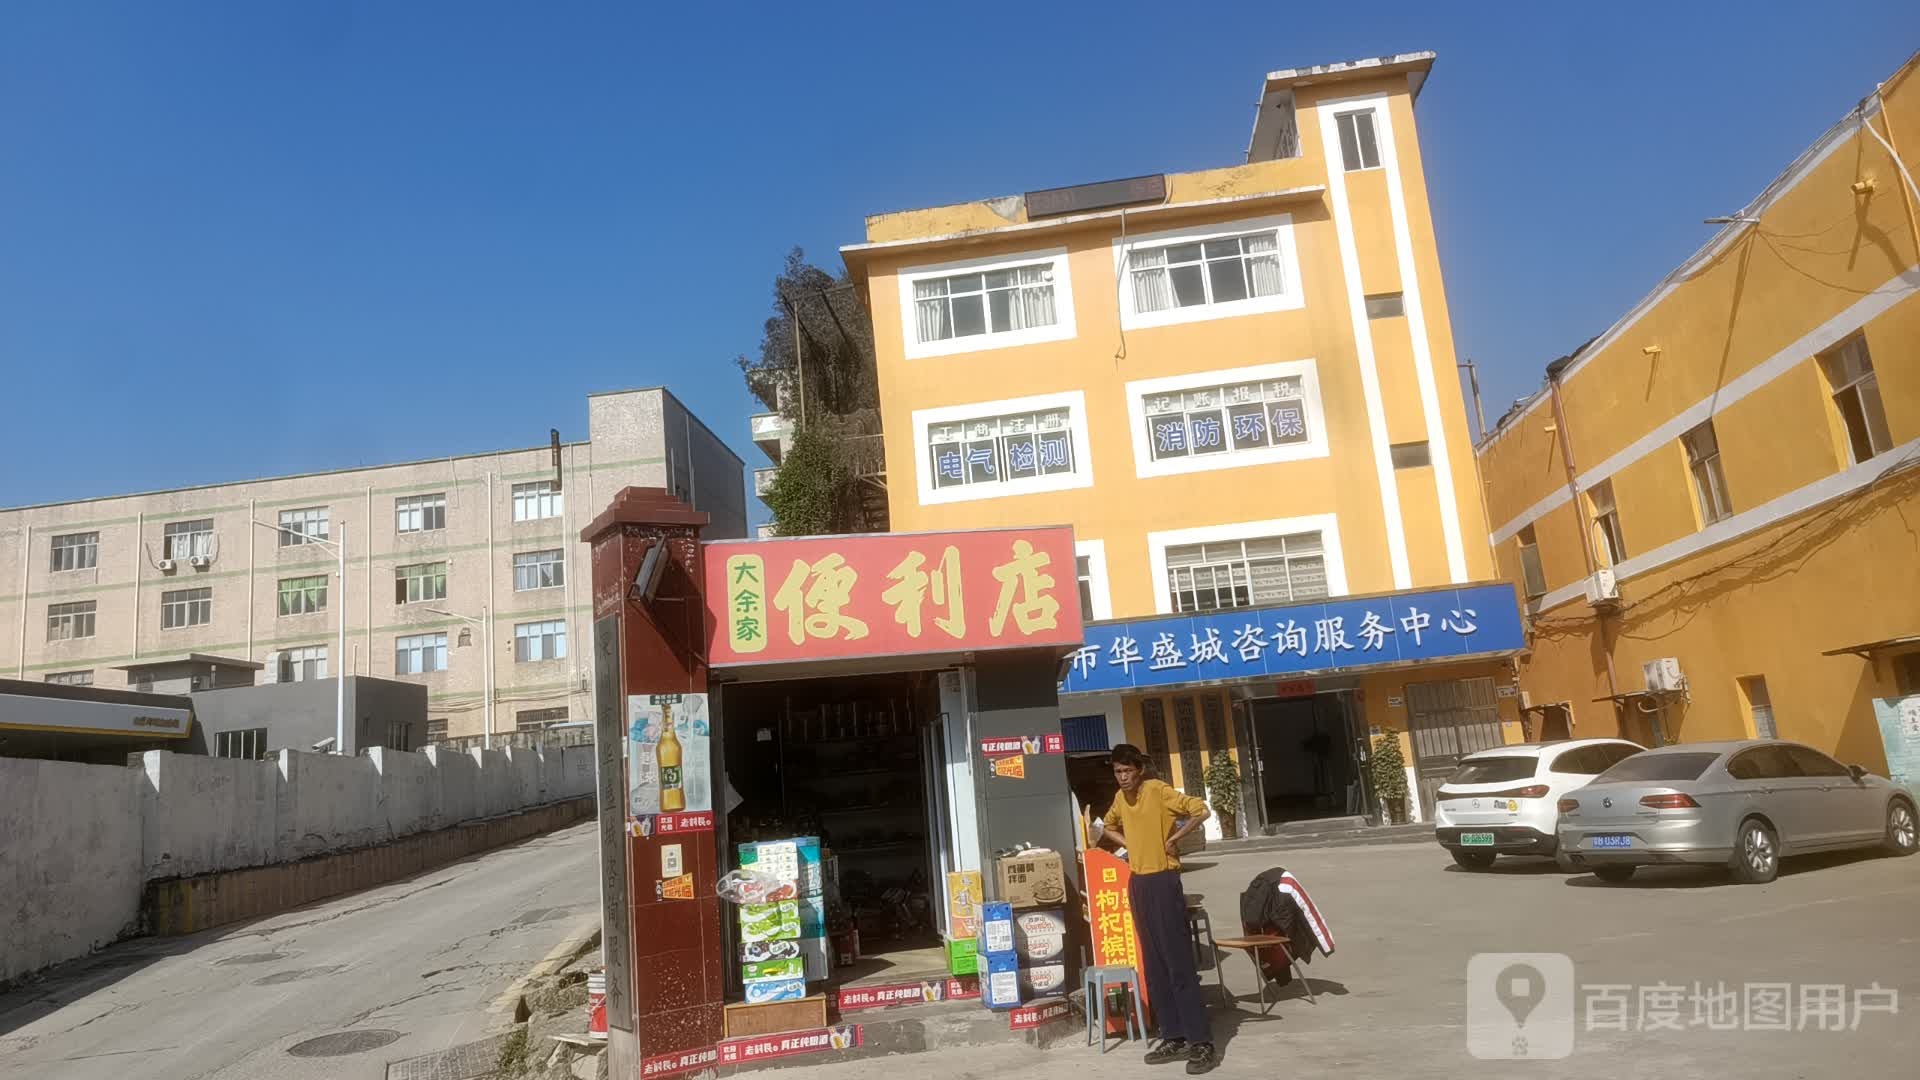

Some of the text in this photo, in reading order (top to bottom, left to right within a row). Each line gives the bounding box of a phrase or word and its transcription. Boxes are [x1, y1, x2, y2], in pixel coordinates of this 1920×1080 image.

[938, 412, 1062, 441] 工商注册
[1154, 382, 1291, 412] 记账报税
[939, 437, 1069, 479] 电气检测
[1156, 408, 1304, 452] 消防环保
[733, 561, 762, 642] 大余家
[773, 540, 1061, 646] 便利店
[1072, 606, 1478, 681] 市华盛城咨询服务中心
[1095, 889, 1128, 966] 枸杞槟
